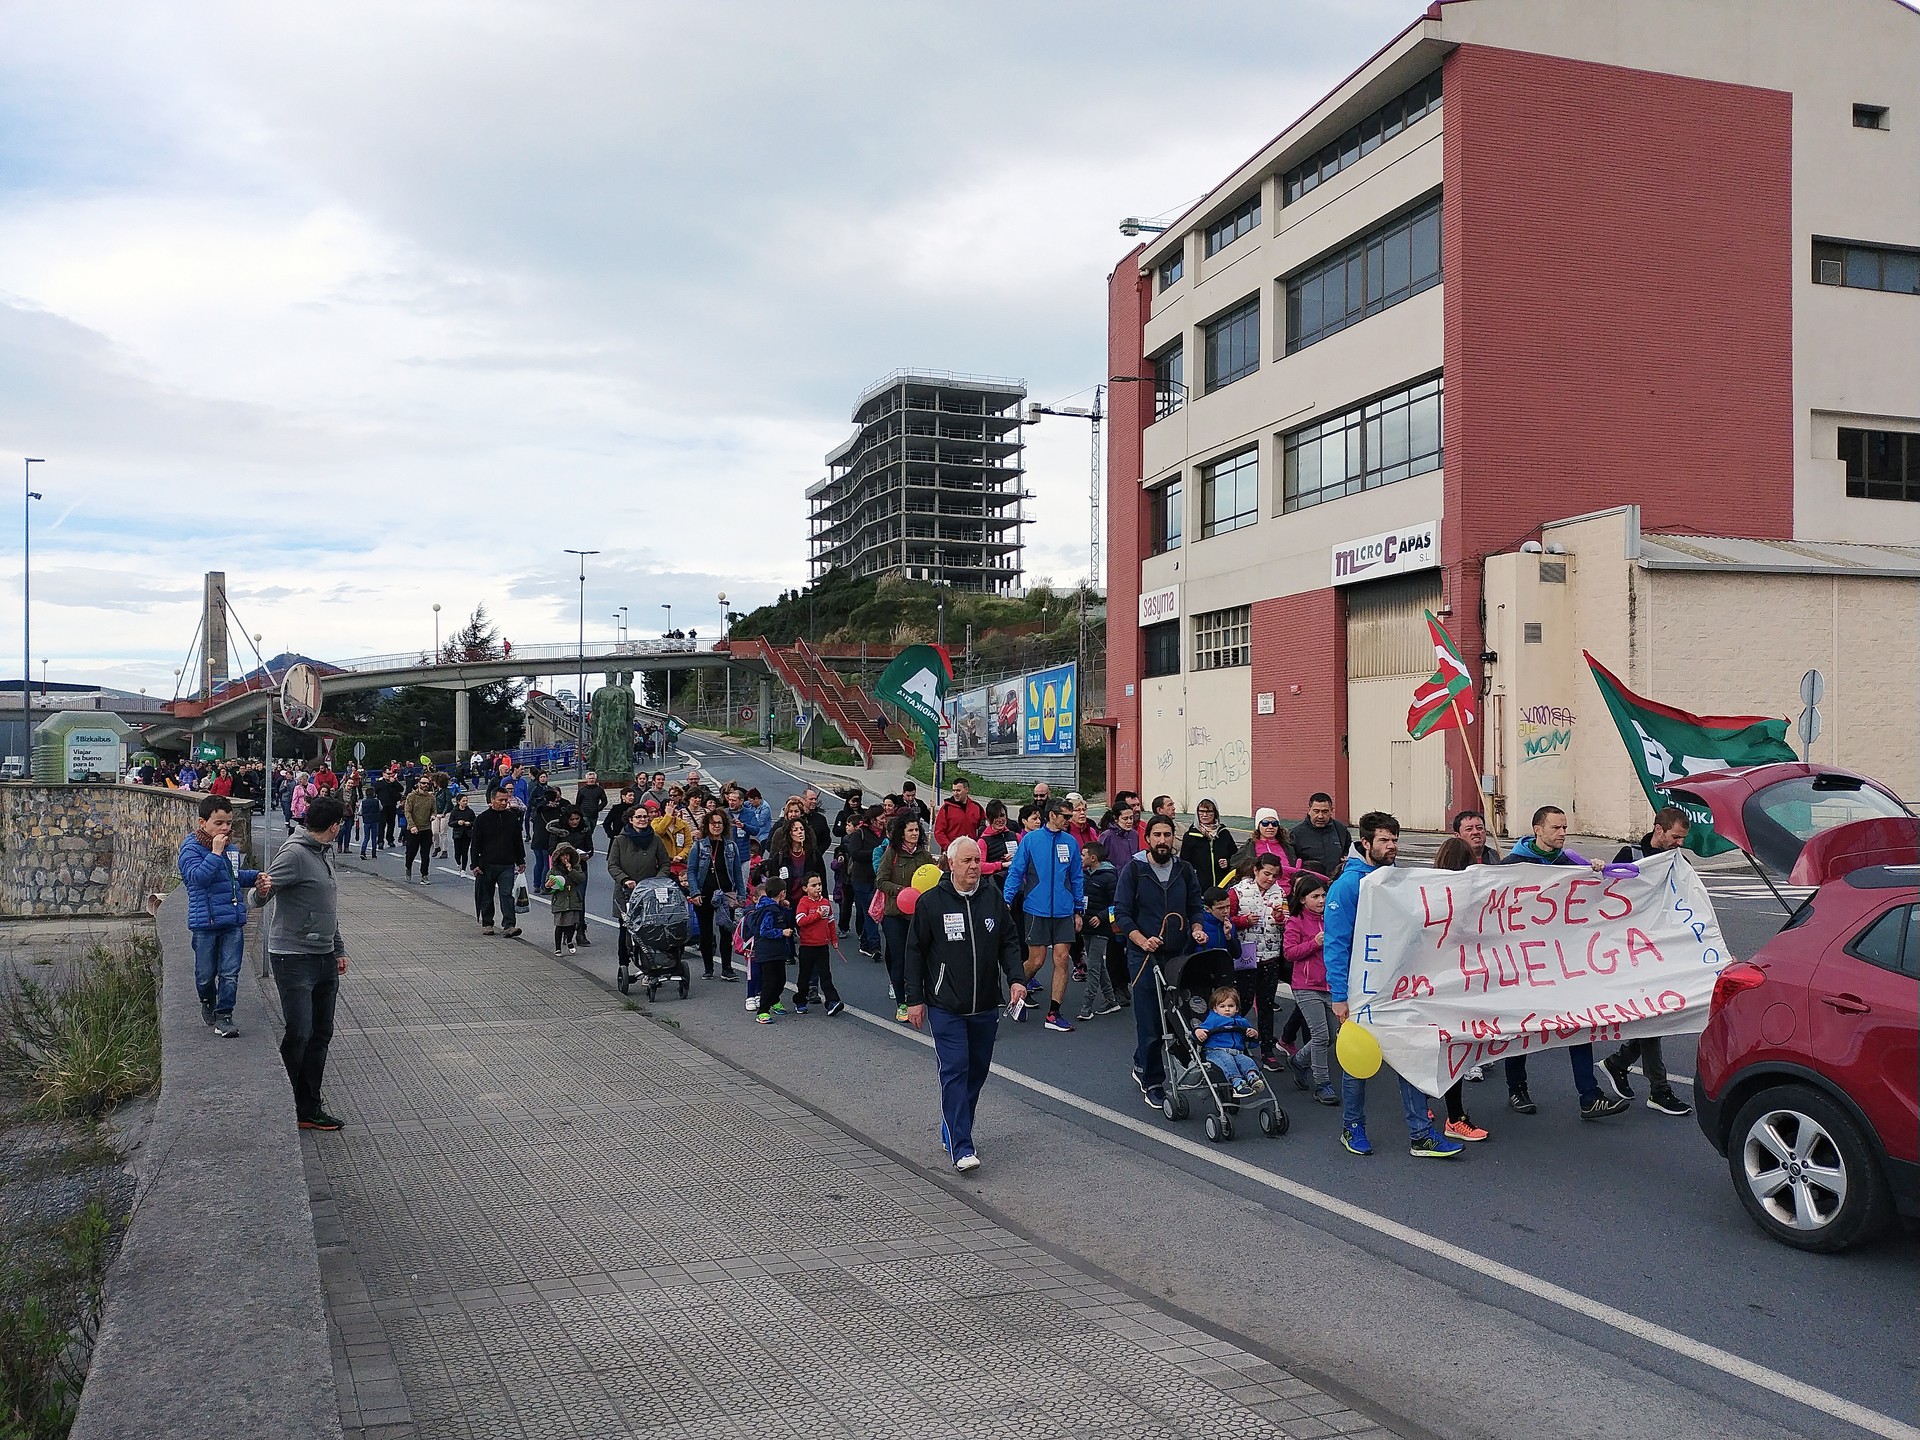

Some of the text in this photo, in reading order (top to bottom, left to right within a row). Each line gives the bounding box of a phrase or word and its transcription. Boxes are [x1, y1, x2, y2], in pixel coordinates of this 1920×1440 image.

[1384, 531, 1432, 564] CAPAS
[1143, 590, 1175, 621] sasyma
[80, 735, 111, 743] Bizkaibus
[1478, 878, 1634, 935] MESES
[1355, 934, 1383, 1025] ELA
[1391, 927, 1665, 1001] en HUELGA
